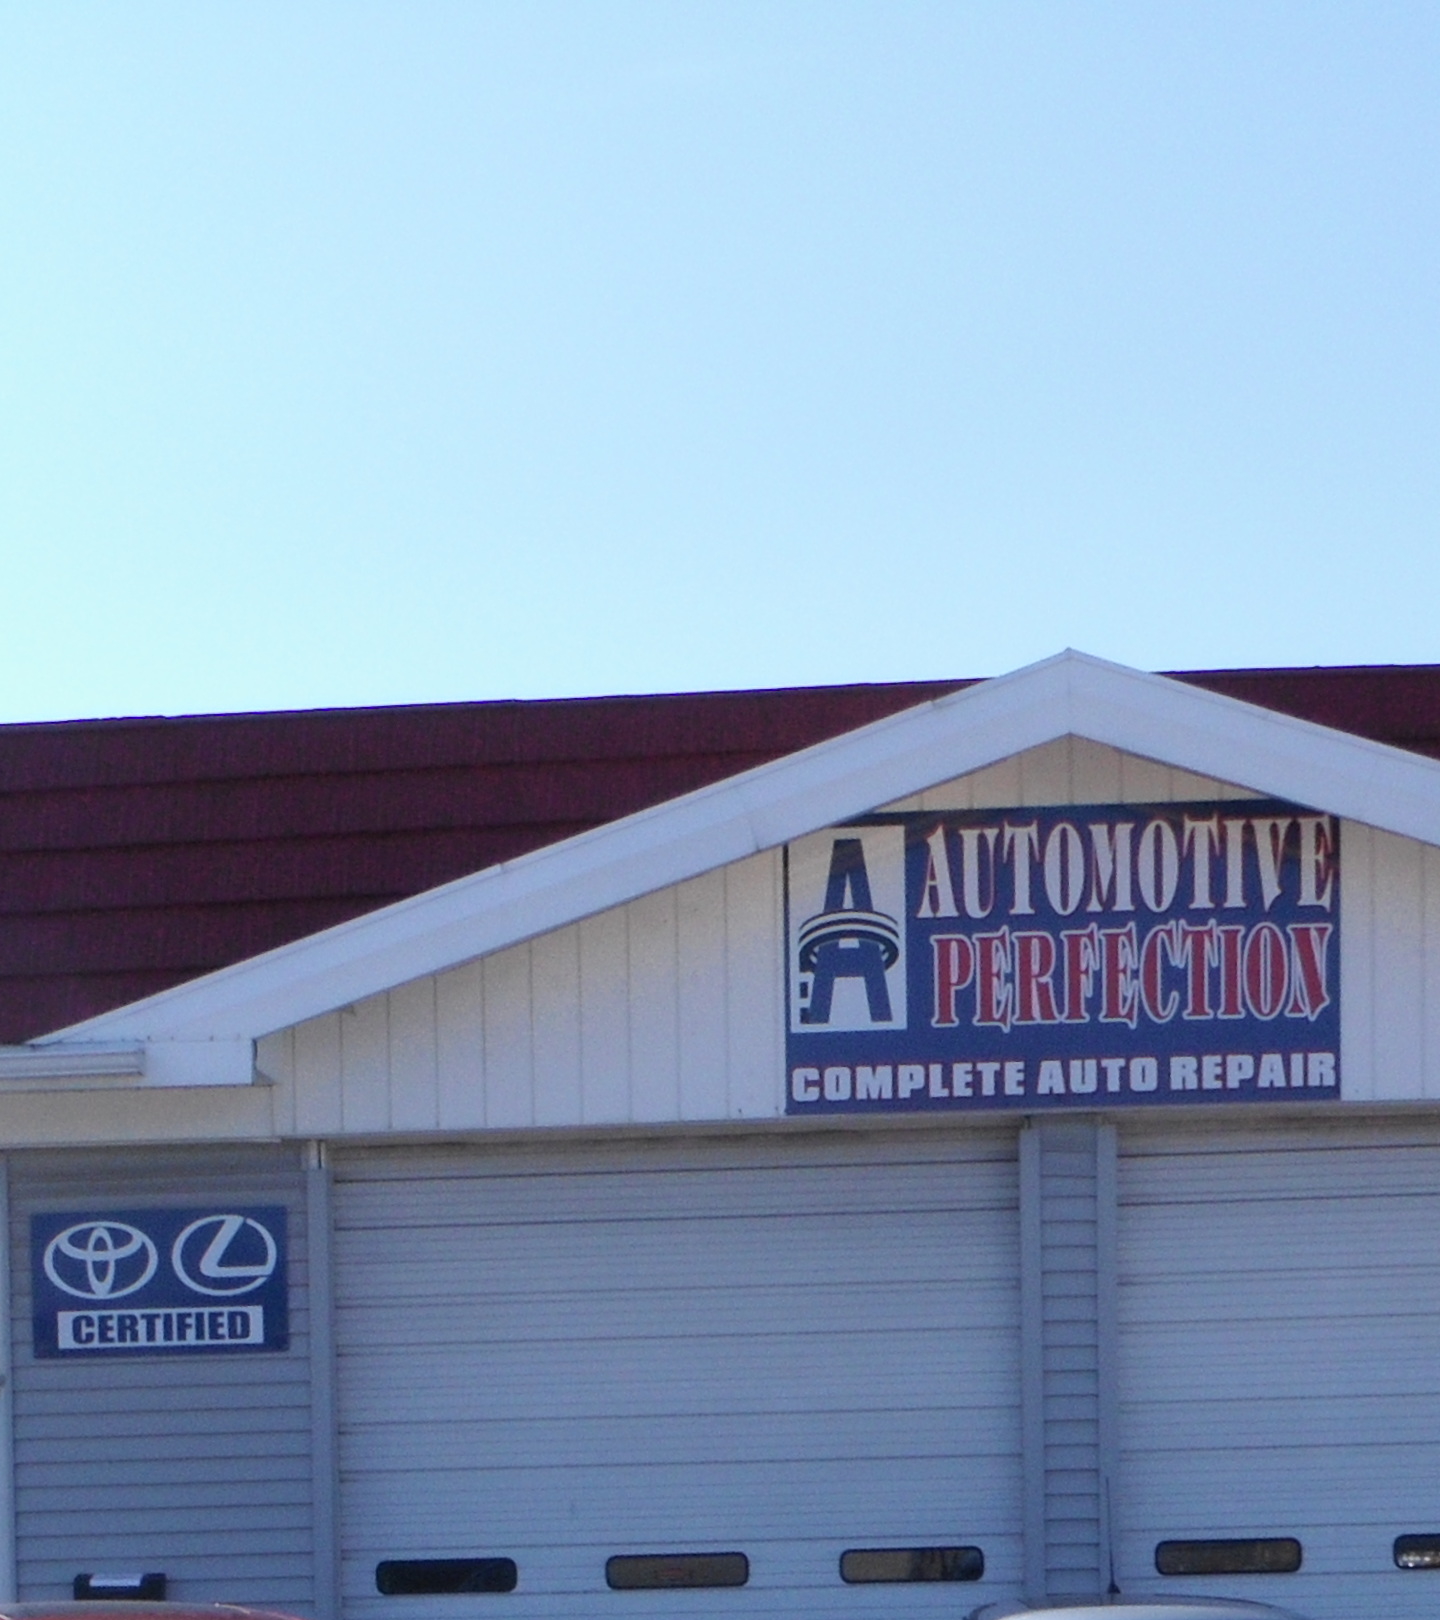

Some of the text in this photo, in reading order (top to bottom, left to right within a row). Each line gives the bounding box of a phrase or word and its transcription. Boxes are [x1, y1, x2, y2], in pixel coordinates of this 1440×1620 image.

[917, 814, 1339, 918] AUTOMOTIVE
[929, 920, 1333, 1033] PERFECTION
[792, 1052, 1336, 1102] COMPLETE AUTO REPAIR
[72, 1309, 251, 1345] CERTIFIED
